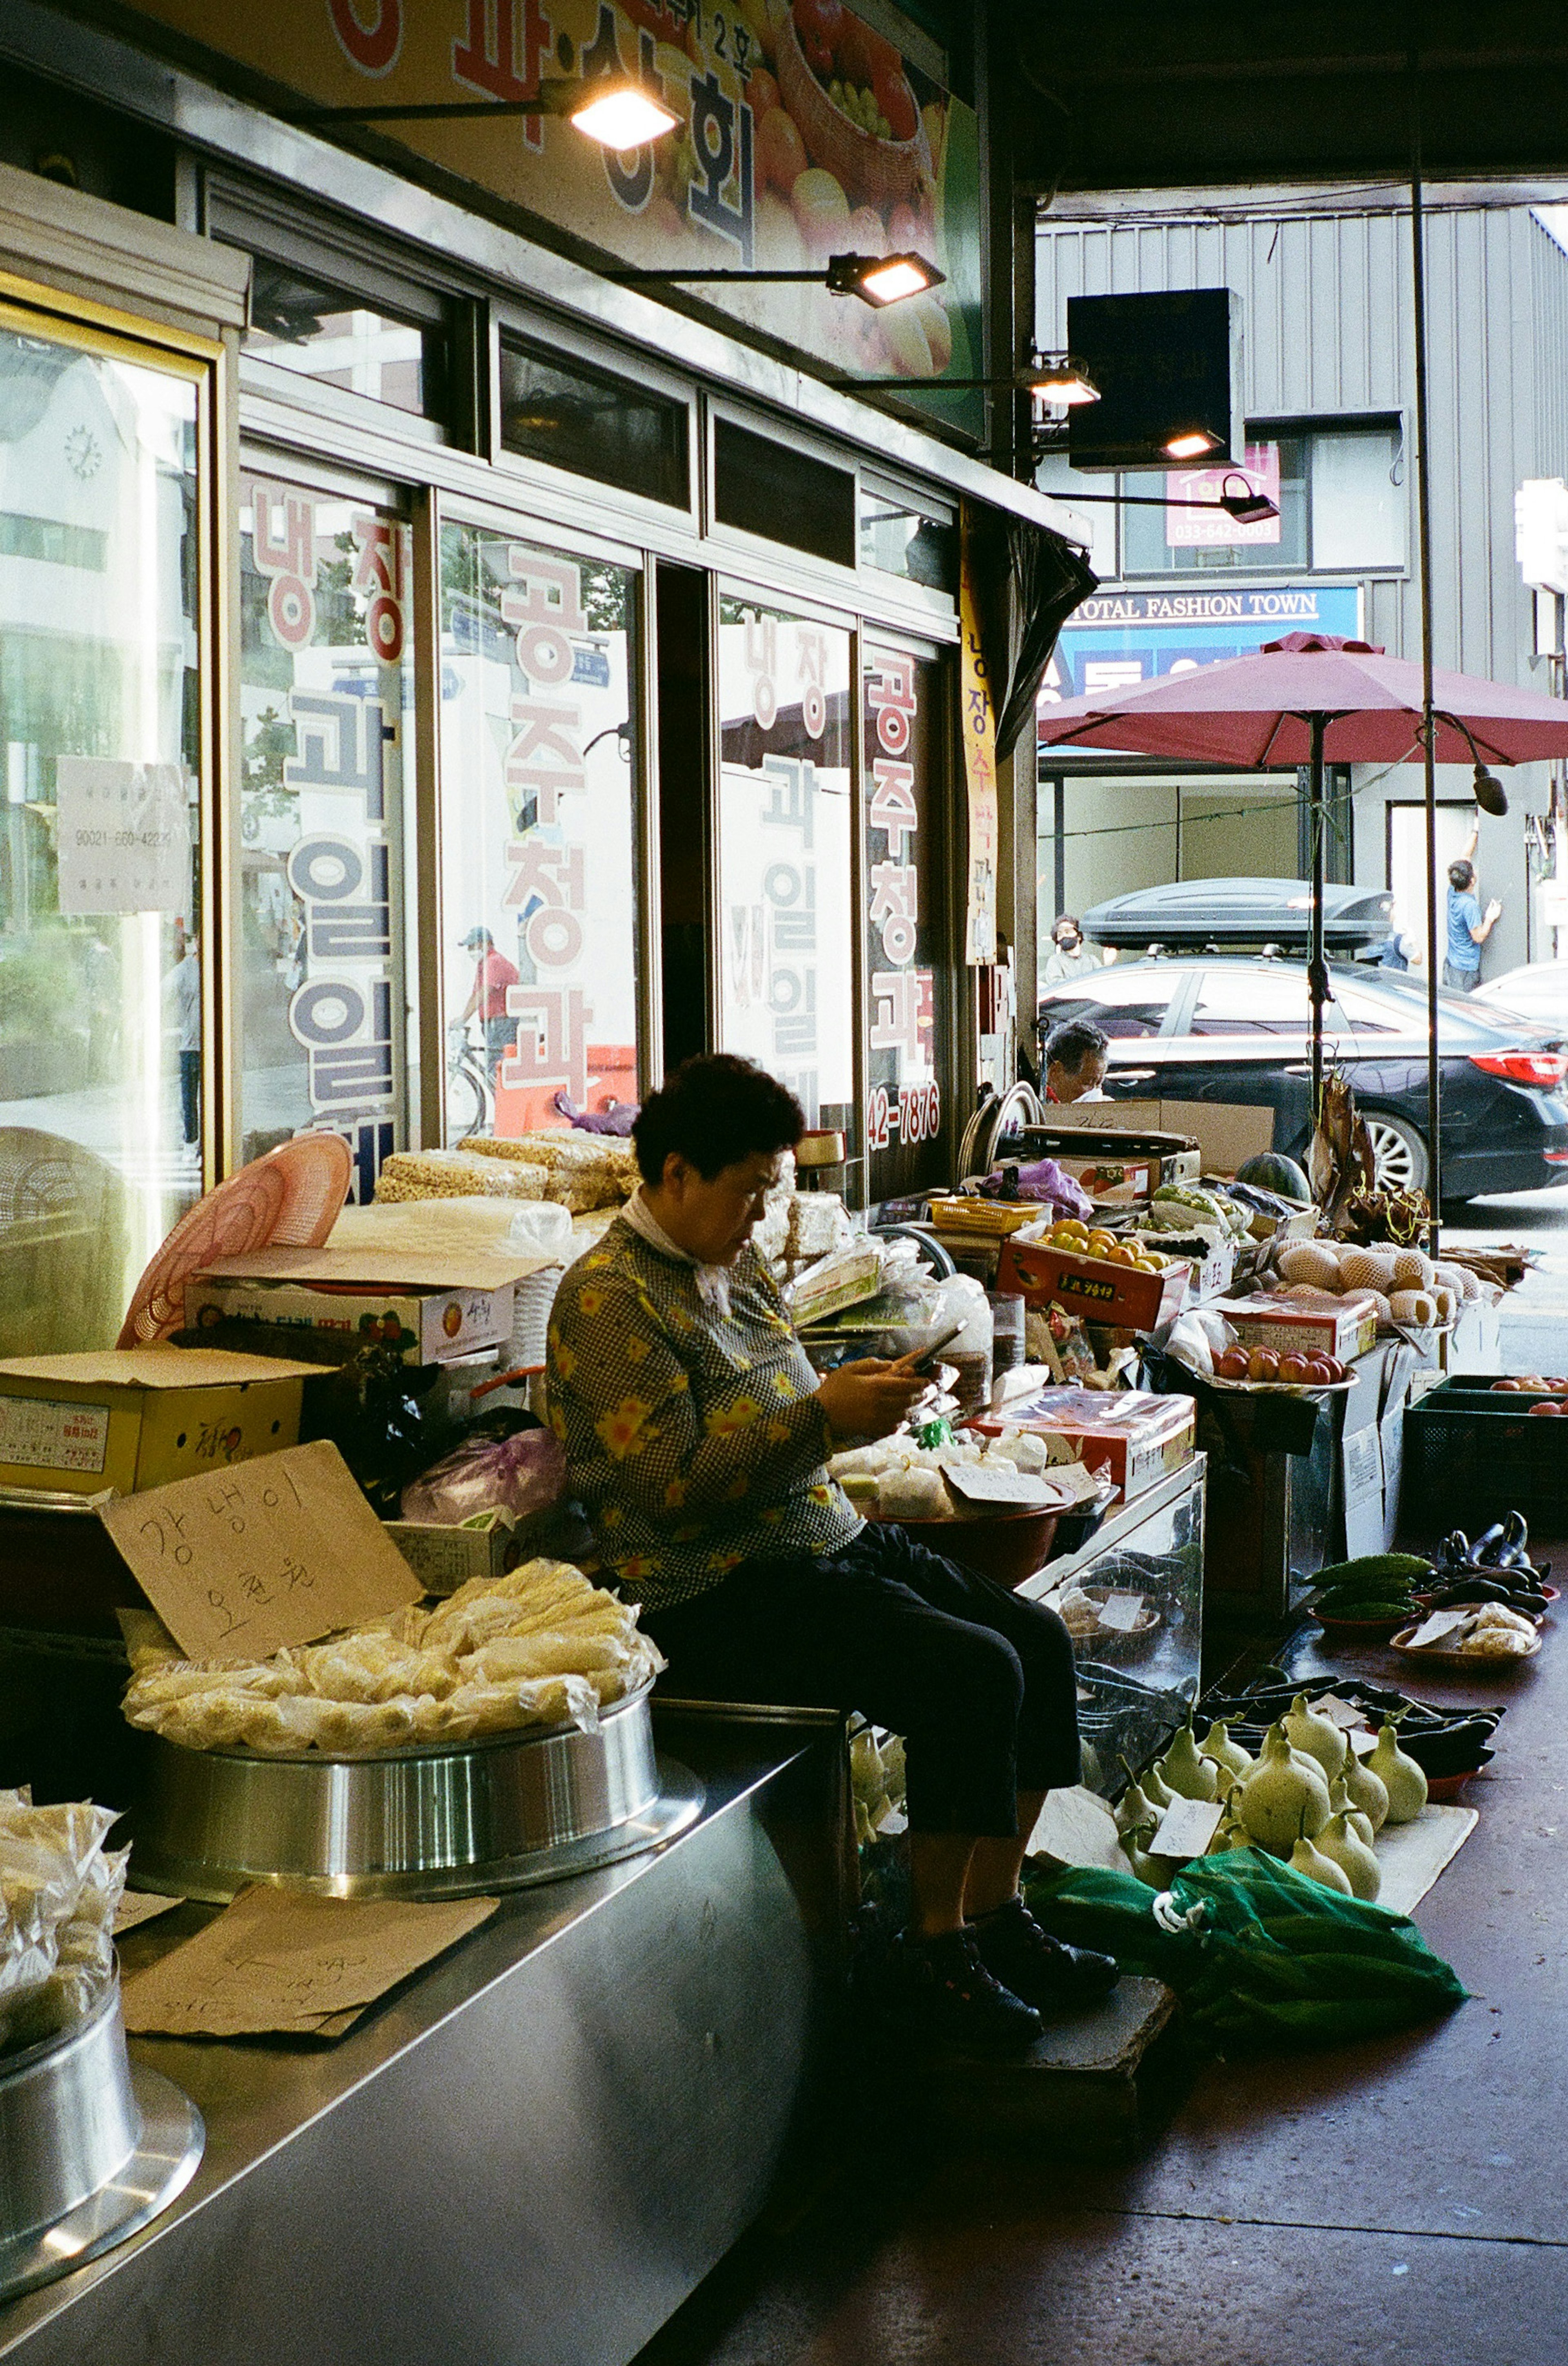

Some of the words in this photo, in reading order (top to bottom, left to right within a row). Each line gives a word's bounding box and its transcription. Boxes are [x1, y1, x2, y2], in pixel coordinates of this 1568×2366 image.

[1174, 524, 1272, 539] 033-642-0003
[1073, 598, 1140, 620] TOTAL
[1146, 595, 1243, 619] FASHION
[1249, 593, 1317, 615] TOWN
[868, 655, 923, 1071] 공주청과
[140, 1468, 302, 1566] 강냉이
